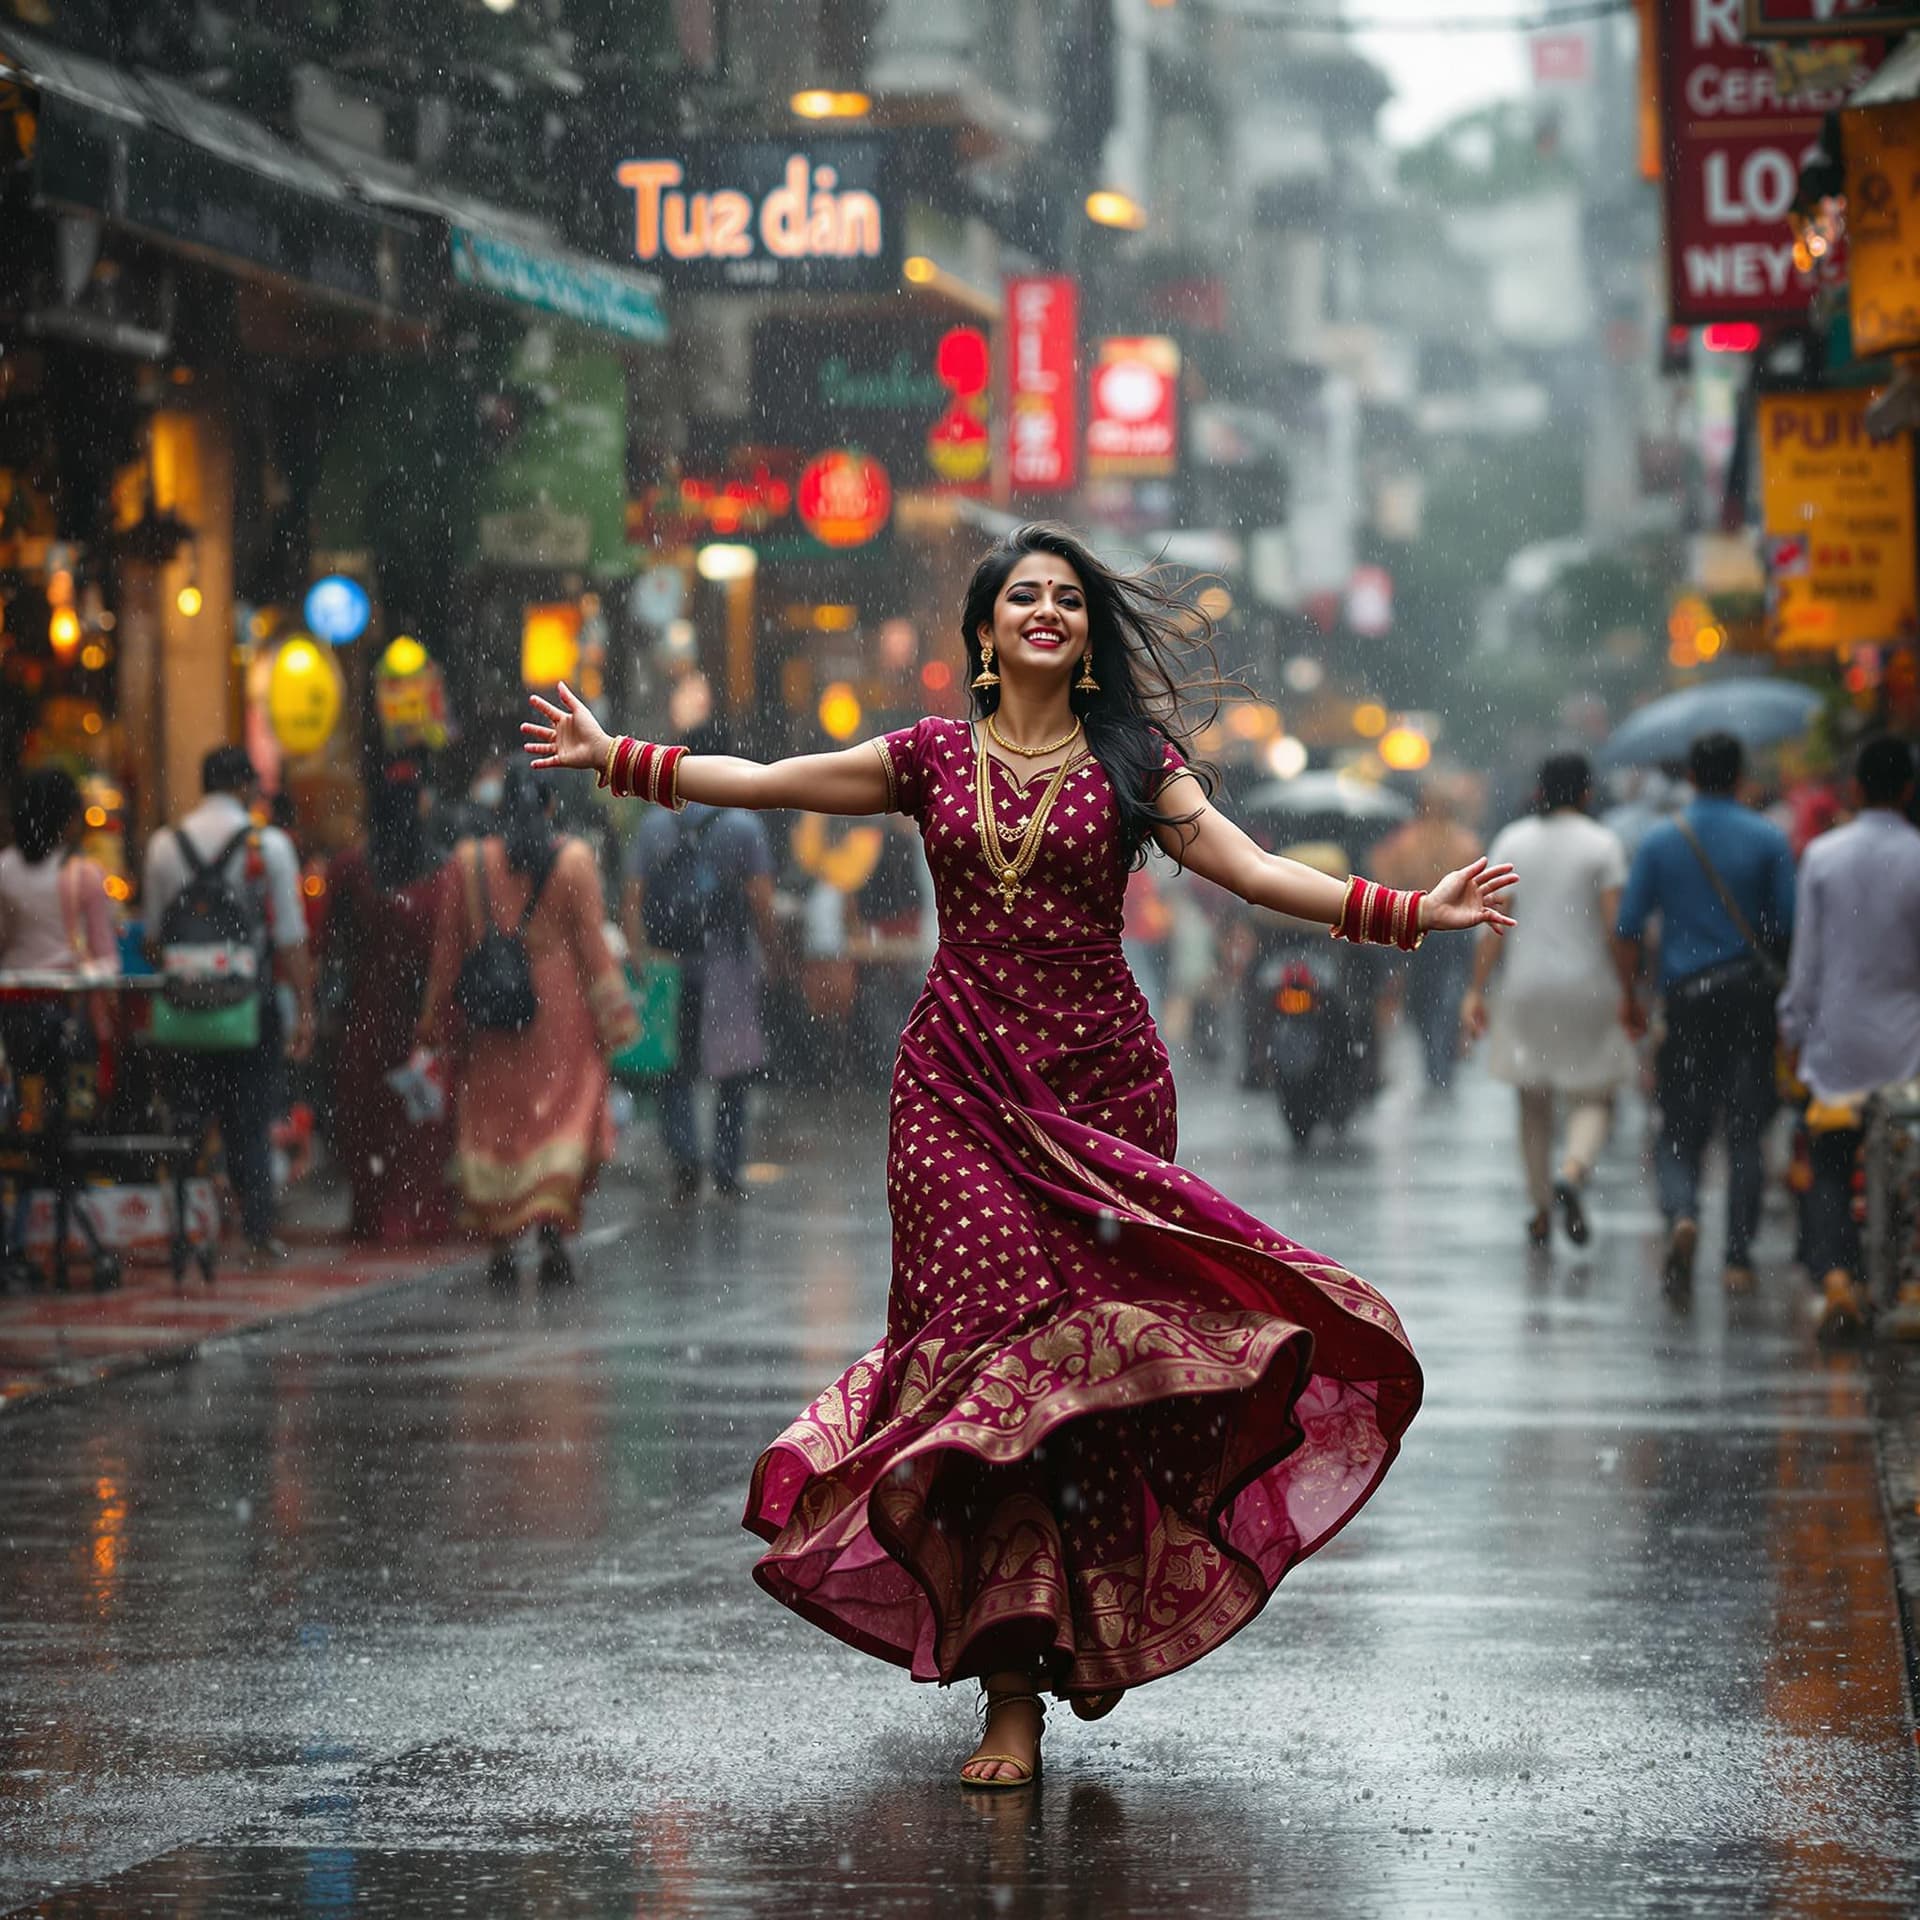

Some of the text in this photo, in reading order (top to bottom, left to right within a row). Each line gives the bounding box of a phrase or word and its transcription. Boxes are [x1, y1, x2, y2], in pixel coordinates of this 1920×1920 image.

[1694, 0, 1743, 46] R
[1704, 146, 1830, 226] LO
[1684, 242, 1800, 298] NEY
